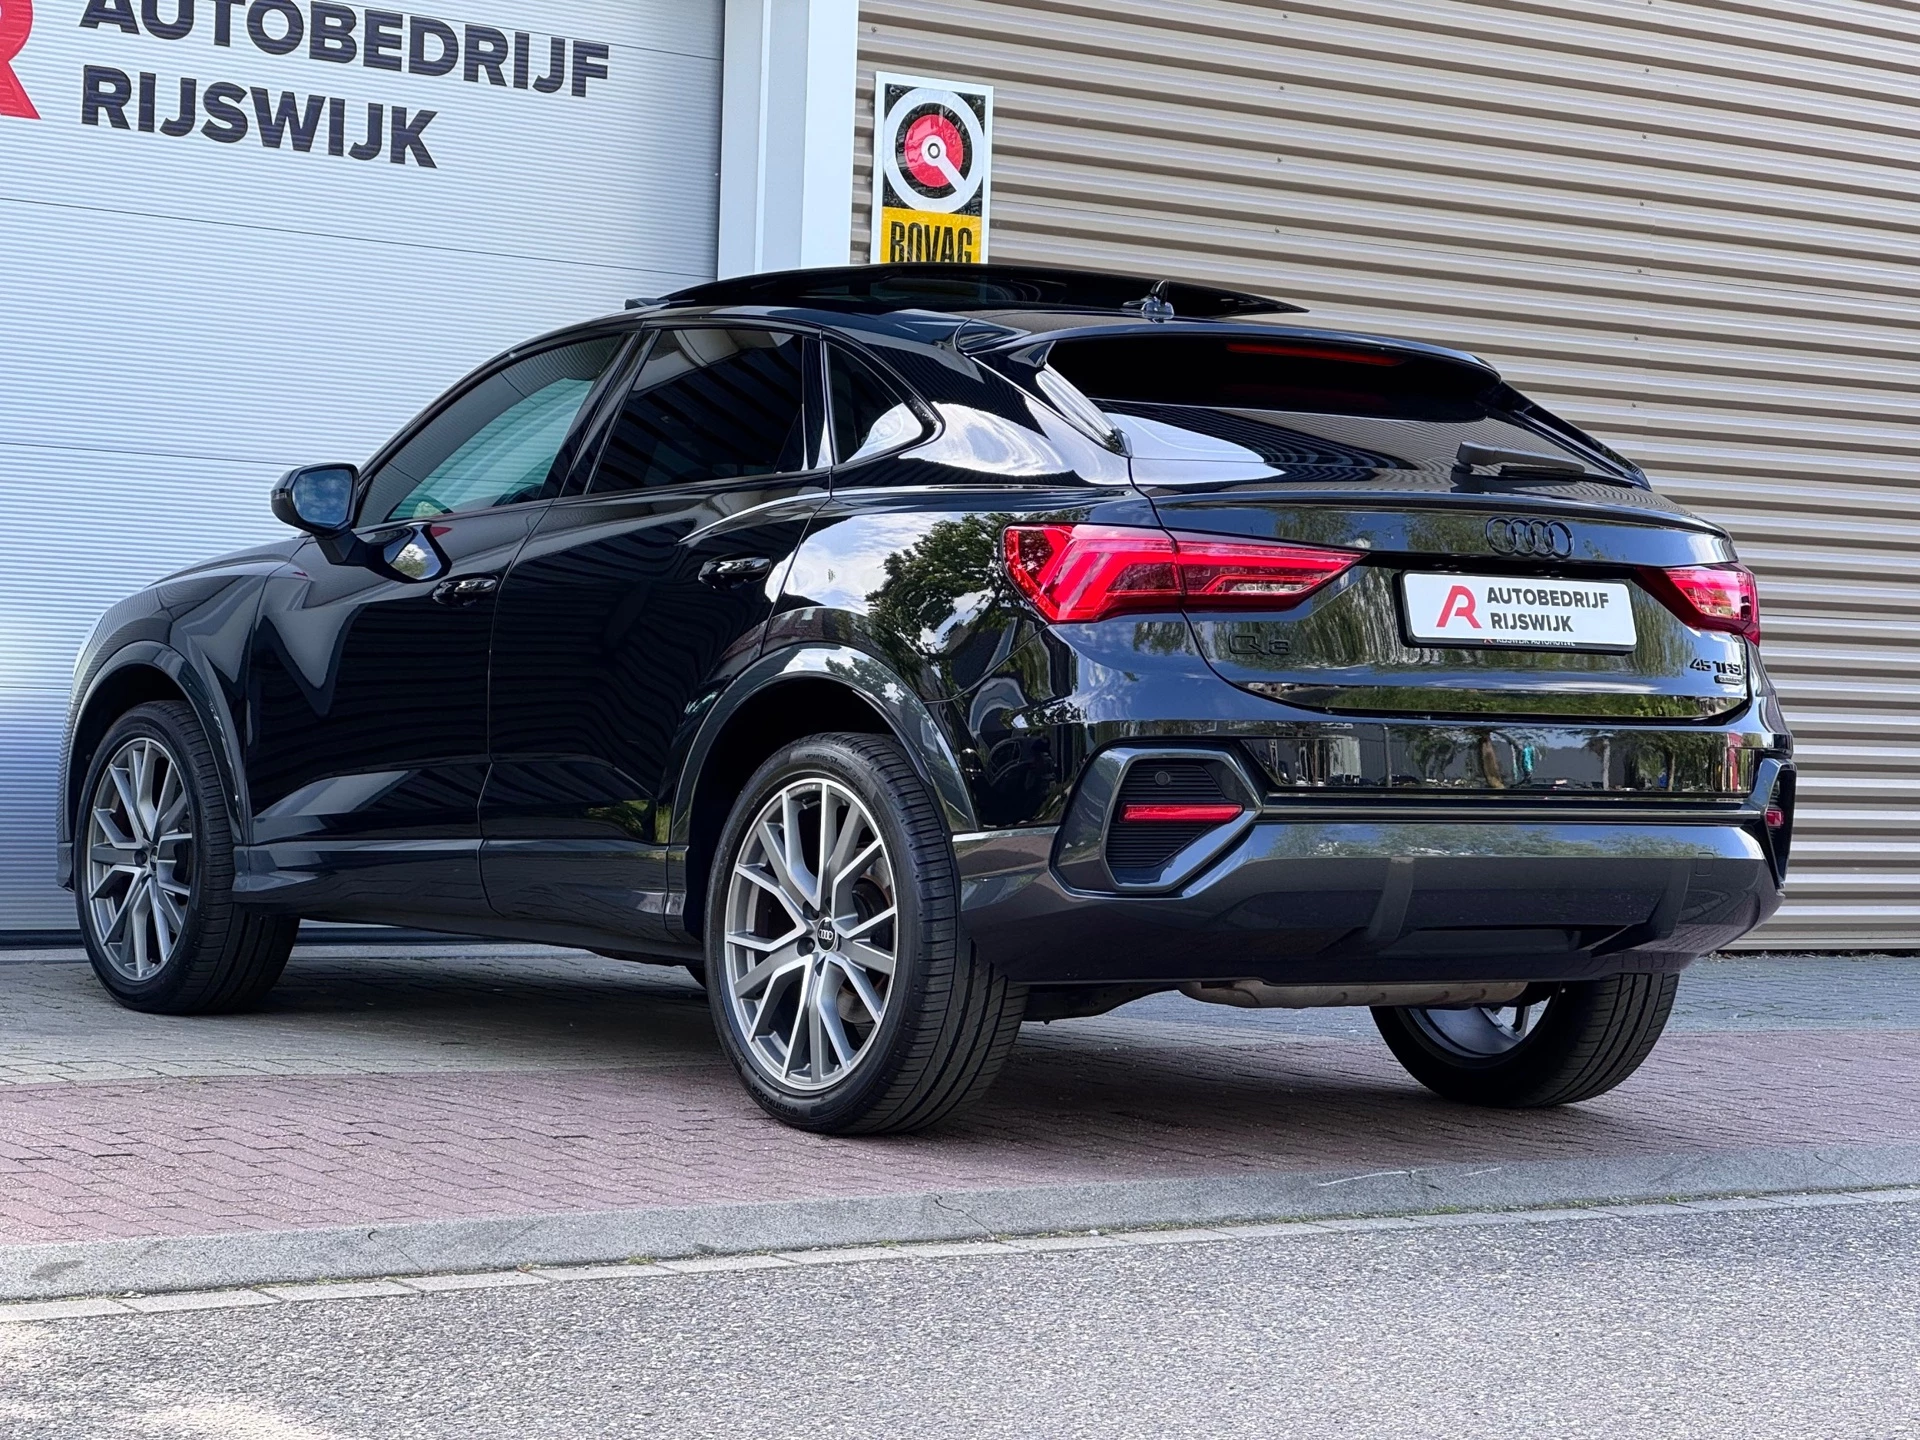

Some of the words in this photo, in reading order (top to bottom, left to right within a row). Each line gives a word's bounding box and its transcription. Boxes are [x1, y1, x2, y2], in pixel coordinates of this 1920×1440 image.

[81, 64, 438, 169] RIJSWIJK
[889, 220, 973, 263] BOVAG
[1486, 586, 1609, 609] AUTOBEDRIJF
[1490, 612, 1574, 633] RIJSWIJK
[1228, 633, 1291, 656] Q3
[1689, 658, 1711, 671] 45
